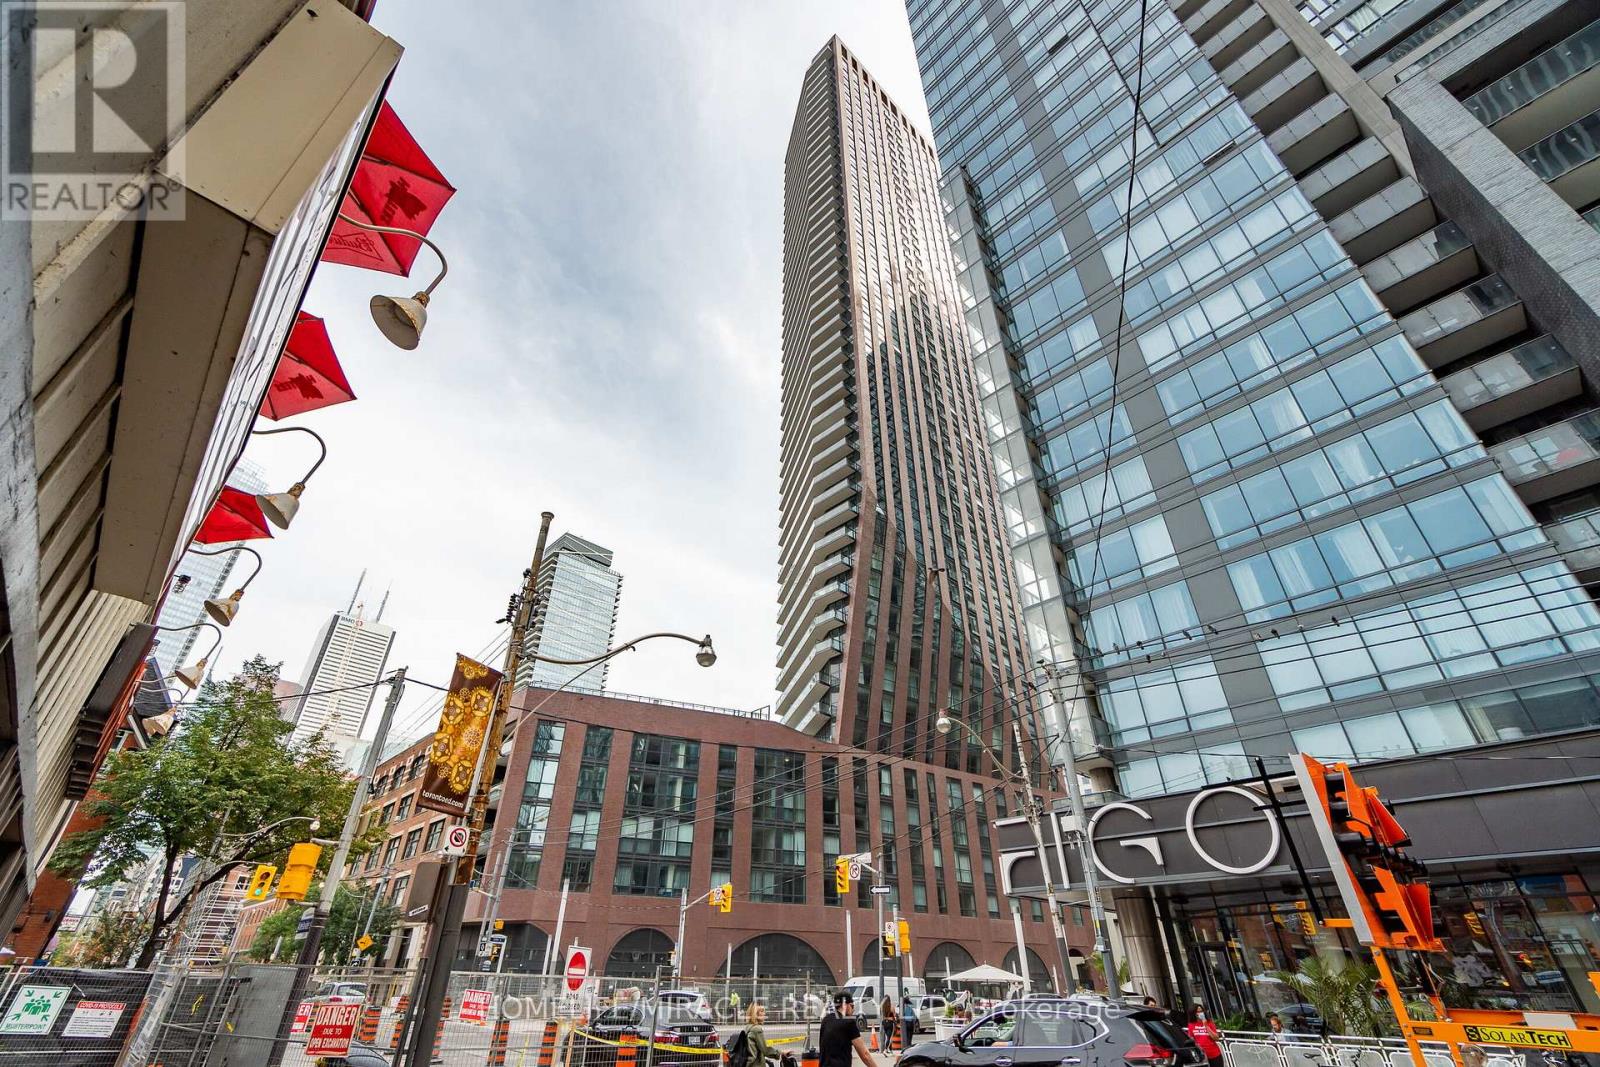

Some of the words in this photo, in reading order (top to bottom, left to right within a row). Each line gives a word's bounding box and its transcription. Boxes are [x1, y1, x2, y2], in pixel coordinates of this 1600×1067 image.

[340, 616, 355, 624] BMO
[422, 789, 464, 809] torontoed.com
[464, 991, 491, 1004] DANGER
[316, 1006, 357, 1026] DANGER
[309, 1038, 322, 1048] OPEN
[322, 1038, 350, 1048] EXCAVATION
